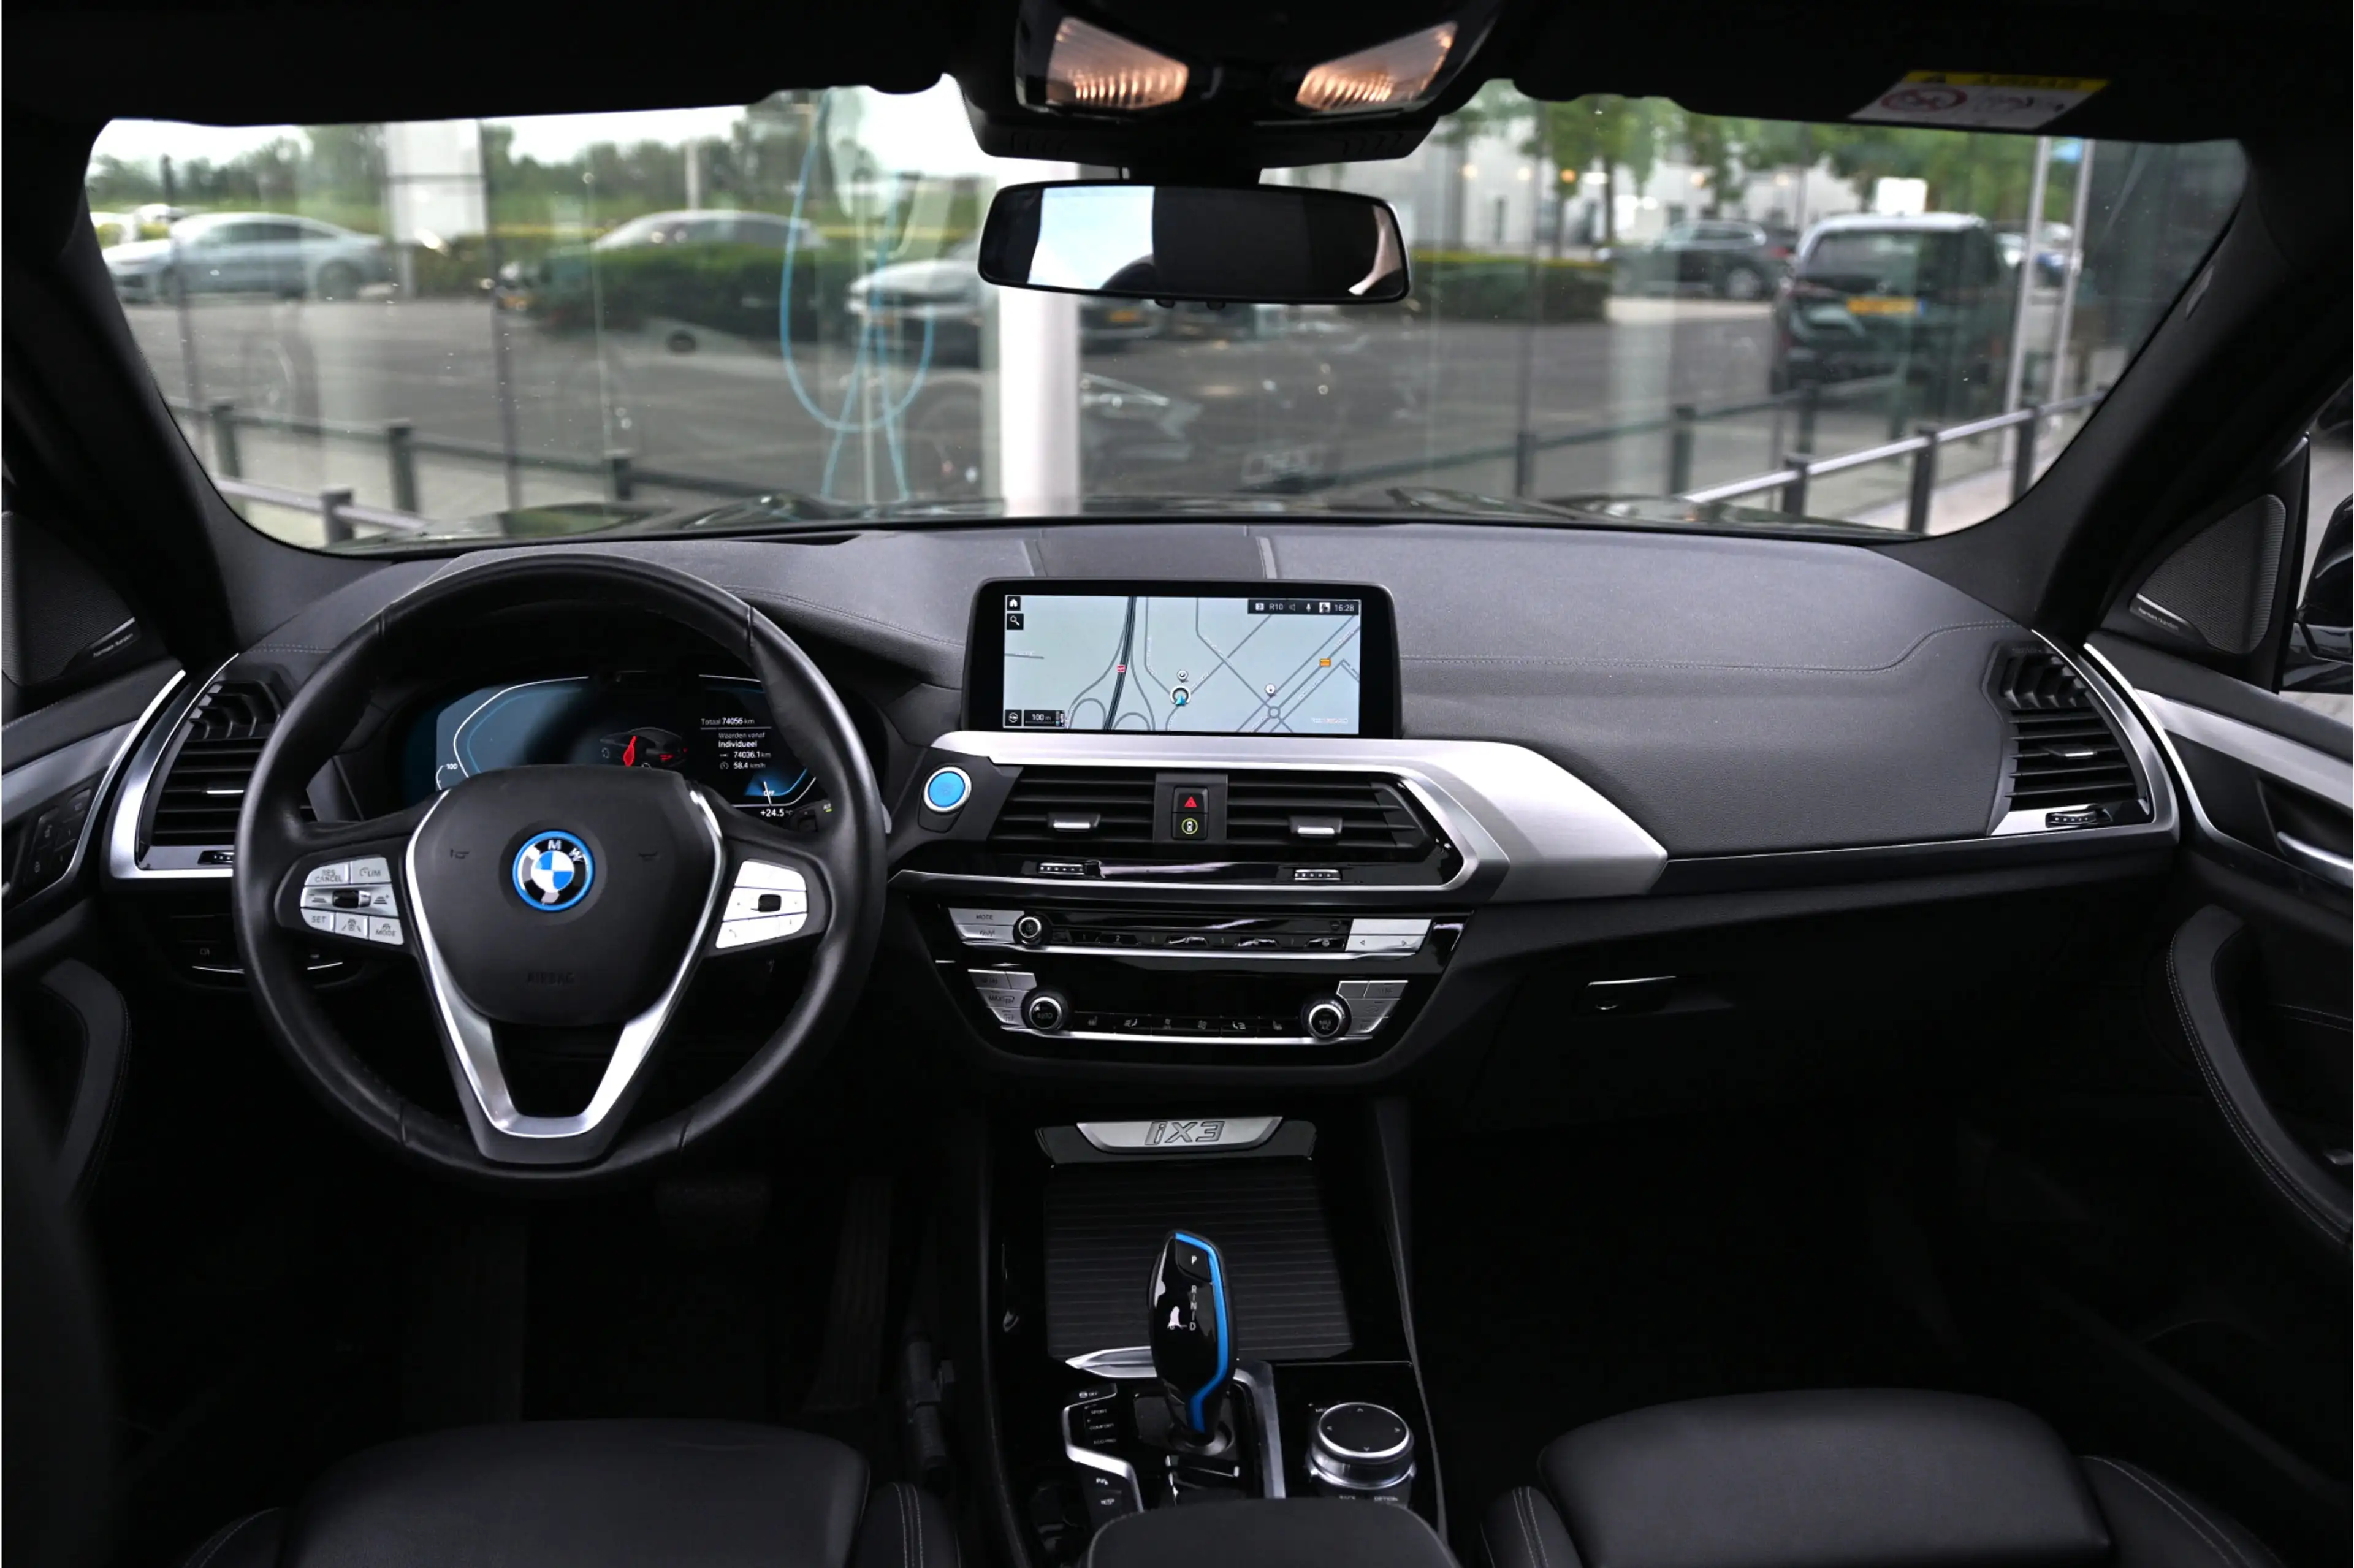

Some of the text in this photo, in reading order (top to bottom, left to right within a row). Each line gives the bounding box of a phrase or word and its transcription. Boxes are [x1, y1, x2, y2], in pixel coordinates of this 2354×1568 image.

[760, 808, 785, 817] +24.5
[1145, 1121, 1225, 1145] iX3
[1191, 1255, 1197, 1265] P
[1190, 1301, 1197, 1311] N
[1189, 1322, 1197, 1331] D
